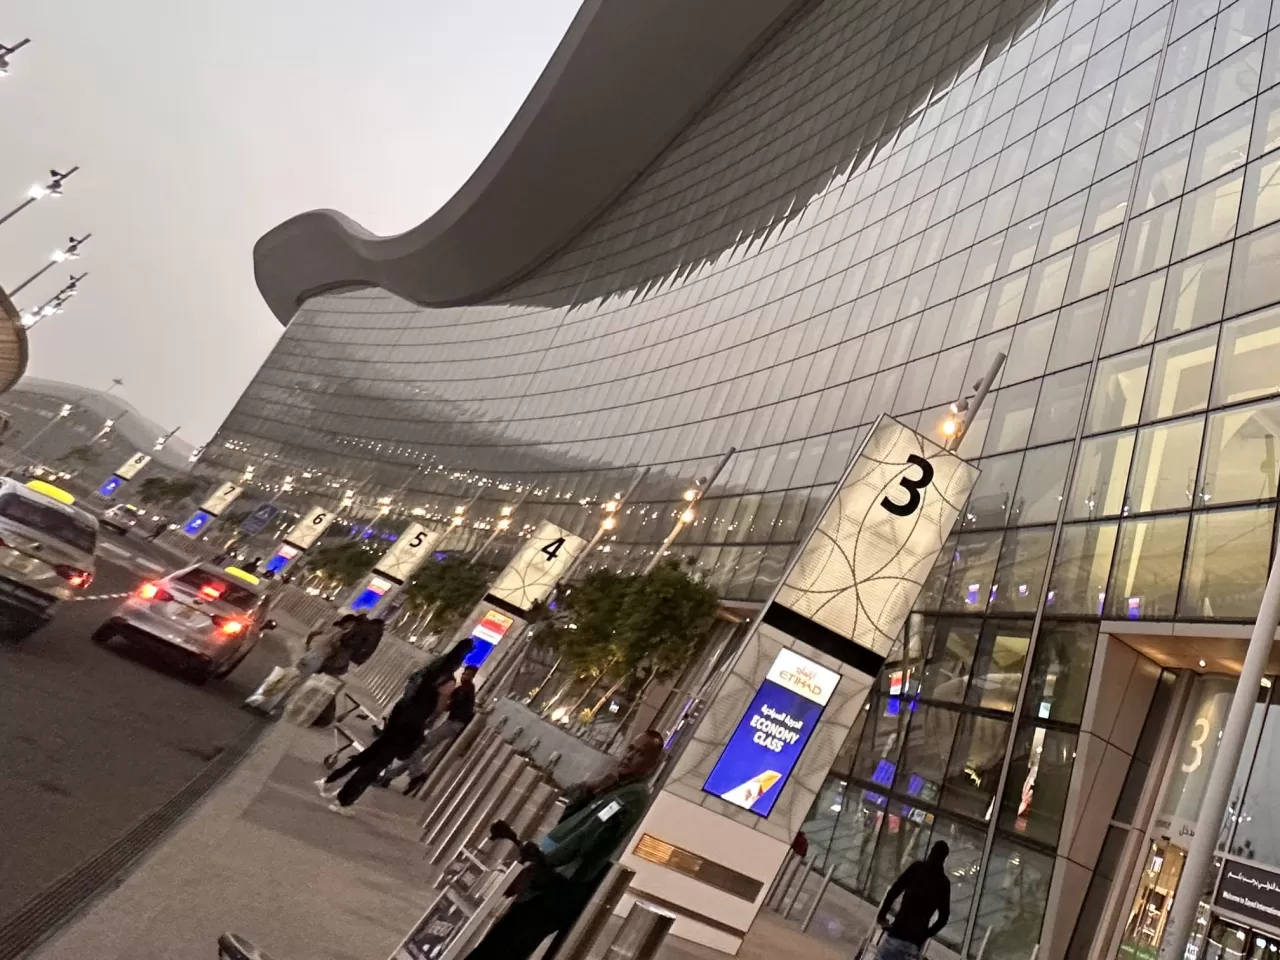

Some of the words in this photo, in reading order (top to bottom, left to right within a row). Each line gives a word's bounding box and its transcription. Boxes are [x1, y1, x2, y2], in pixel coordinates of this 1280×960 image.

[134, 455, 145, 464] 8
[224, 486, 235, 496] 7
[880, 454, 934, 516] 3
[313, 513, 326, 525] 6
[409, 531, 428, 548] 5
[540, 537, 566, 561] 4
[779, 670, 822, 695] ETIHAD
[749, 714, 800, 745] ECONOMY
[753, 731, 785, 753] CLASS
[1181, 718, 1209, 773] 3
